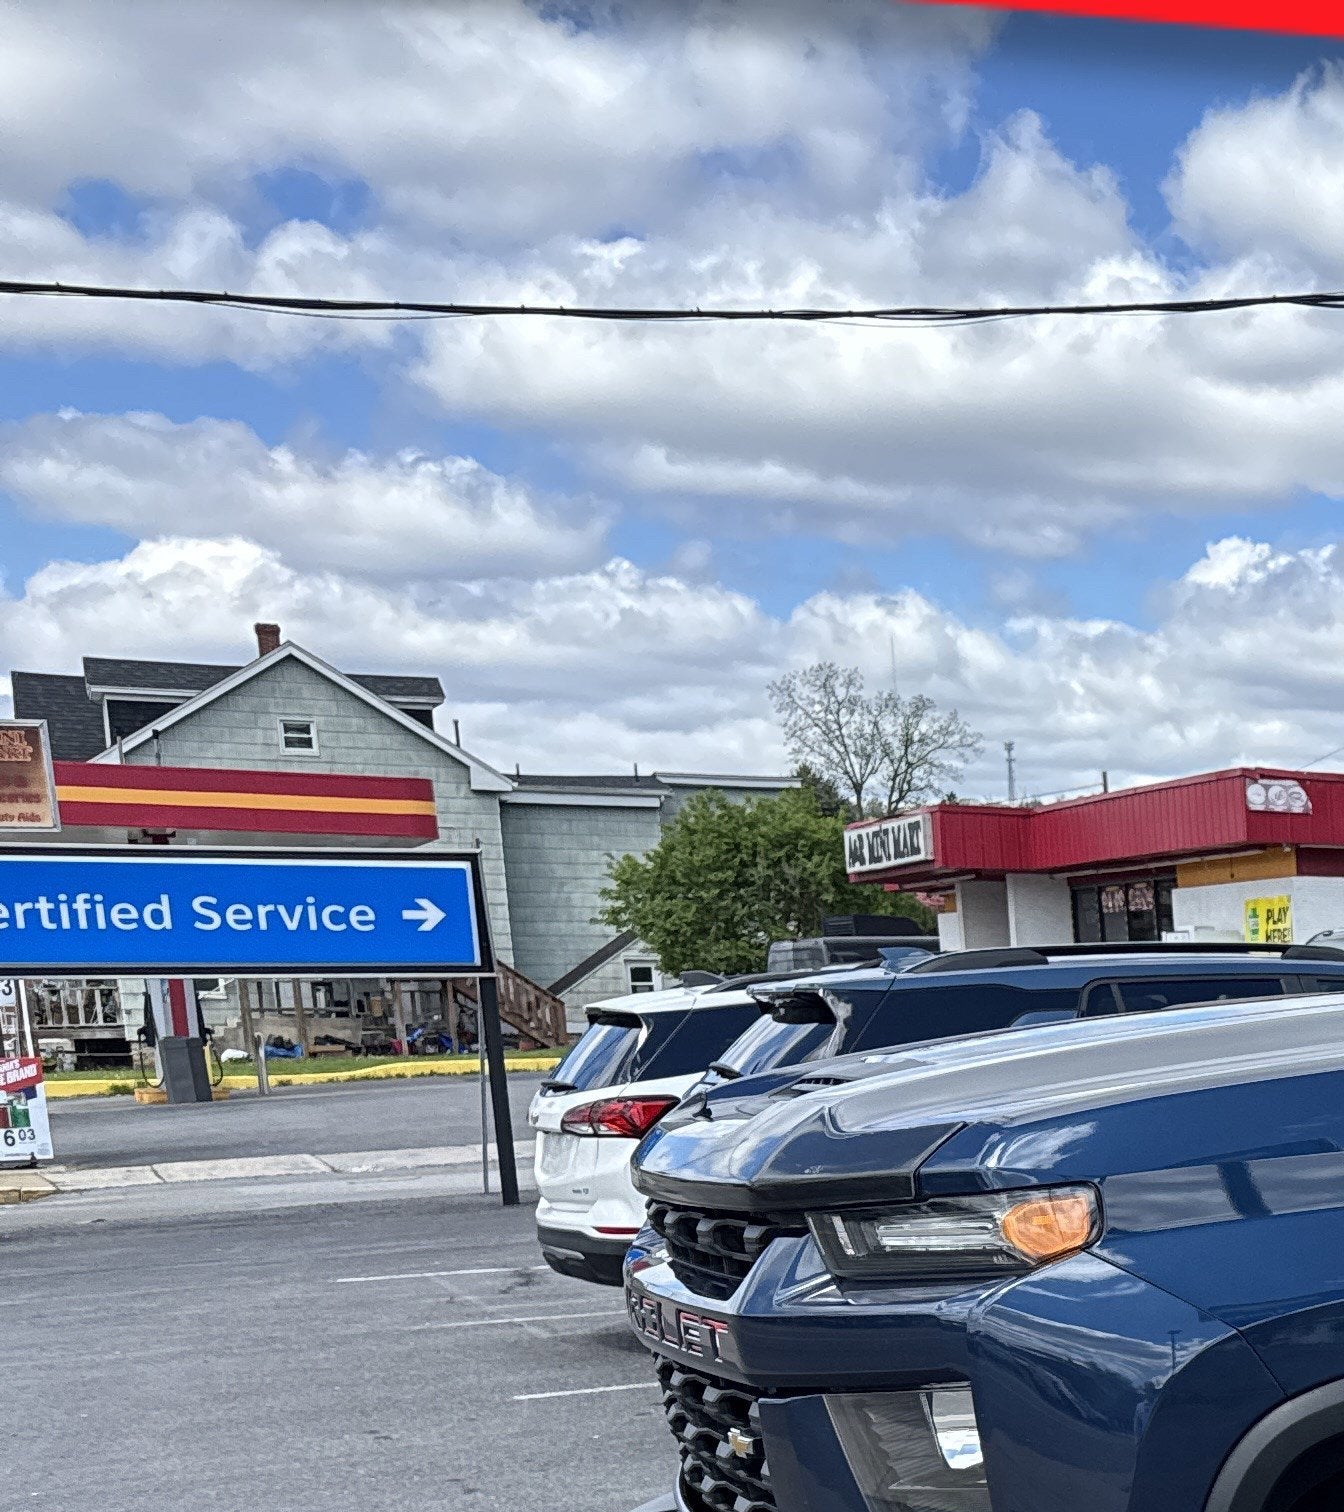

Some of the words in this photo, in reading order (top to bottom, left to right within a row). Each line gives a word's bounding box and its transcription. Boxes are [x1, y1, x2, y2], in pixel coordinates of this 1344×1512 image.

[191, 896, 376, 932] Service
[1266, 906, 1290, 925] PLAY
[6, 1063, 38, 1084] BRAND
